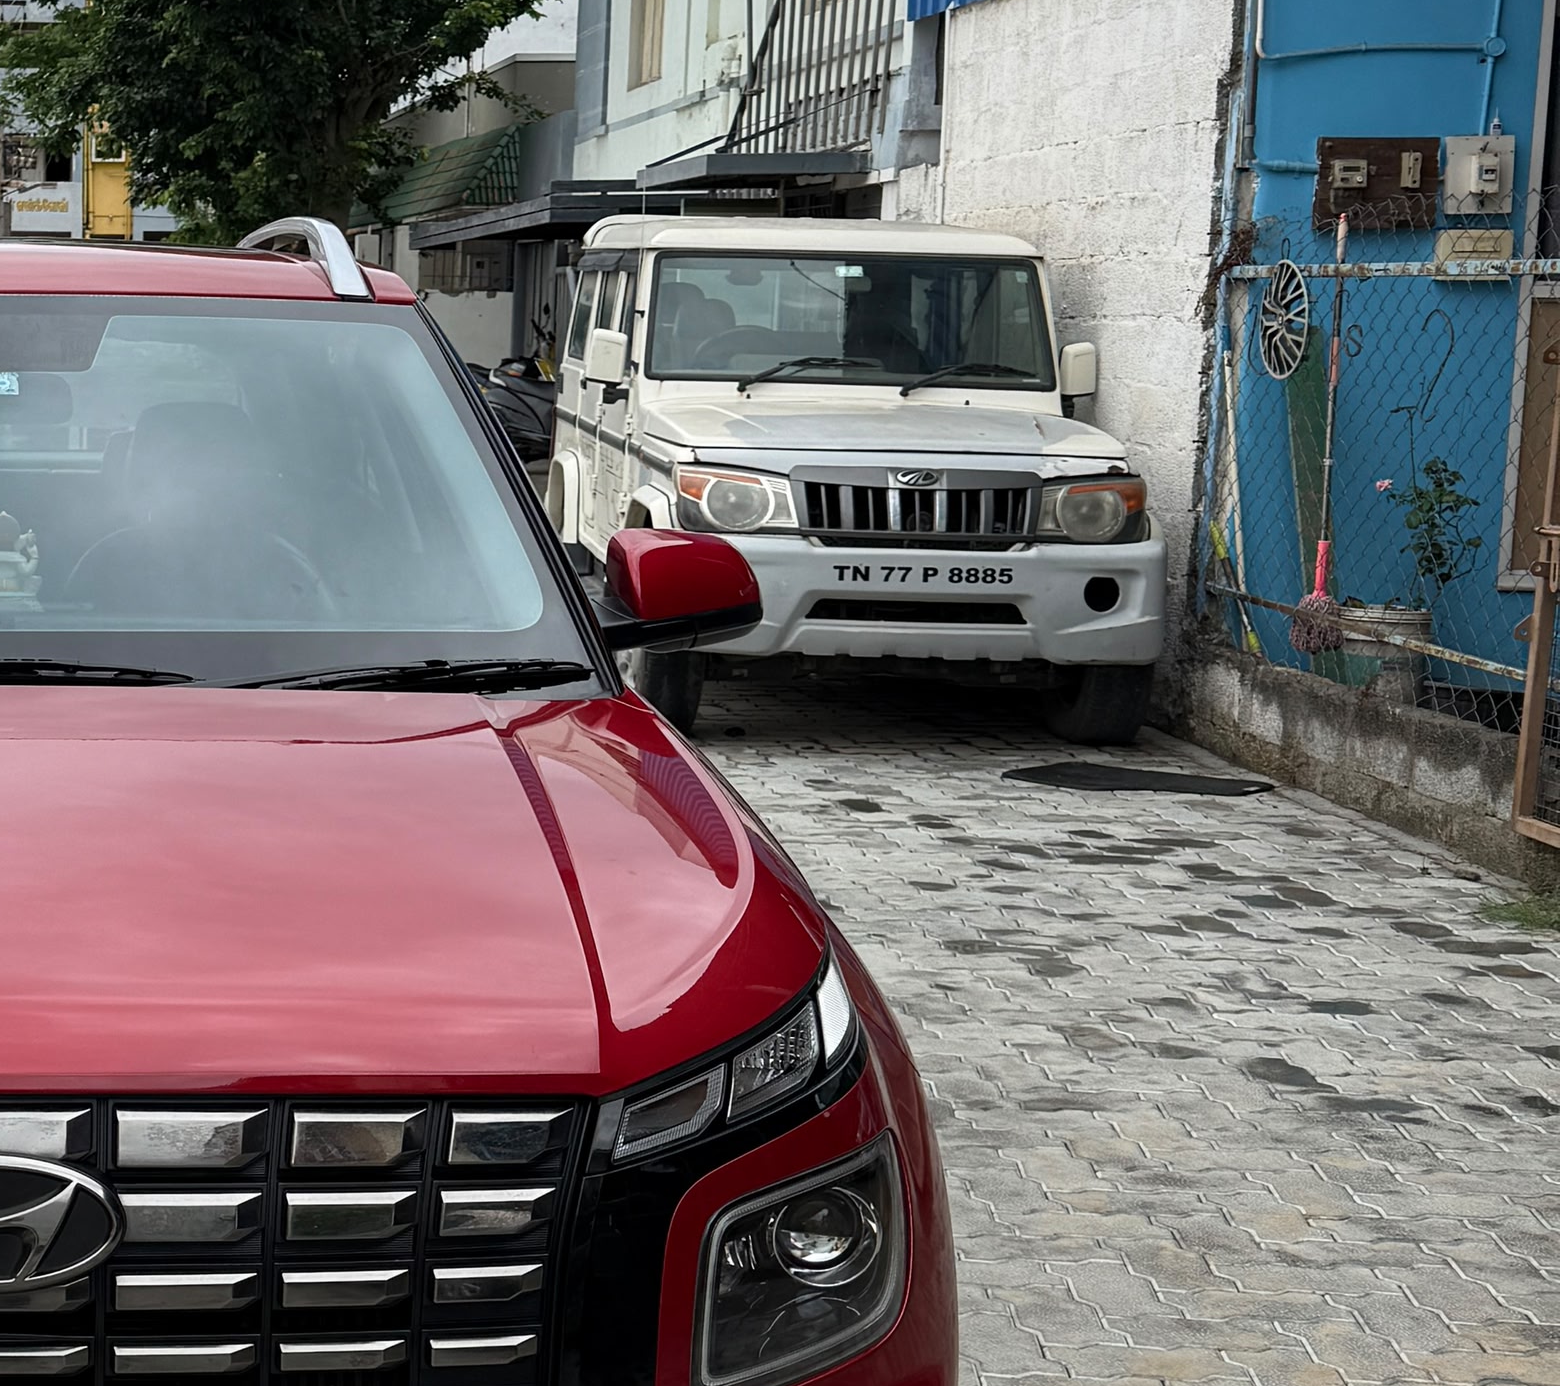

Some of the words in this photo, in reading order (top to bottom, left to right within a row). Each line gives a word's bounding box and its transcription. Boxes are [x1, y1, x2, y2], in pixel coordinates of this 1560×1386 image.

[833, 565, 871, 582] TN
[881, 566, 913, 583] 77
[922, 566, 939, 583] P
[948, 567, 1014, 584] 8885
